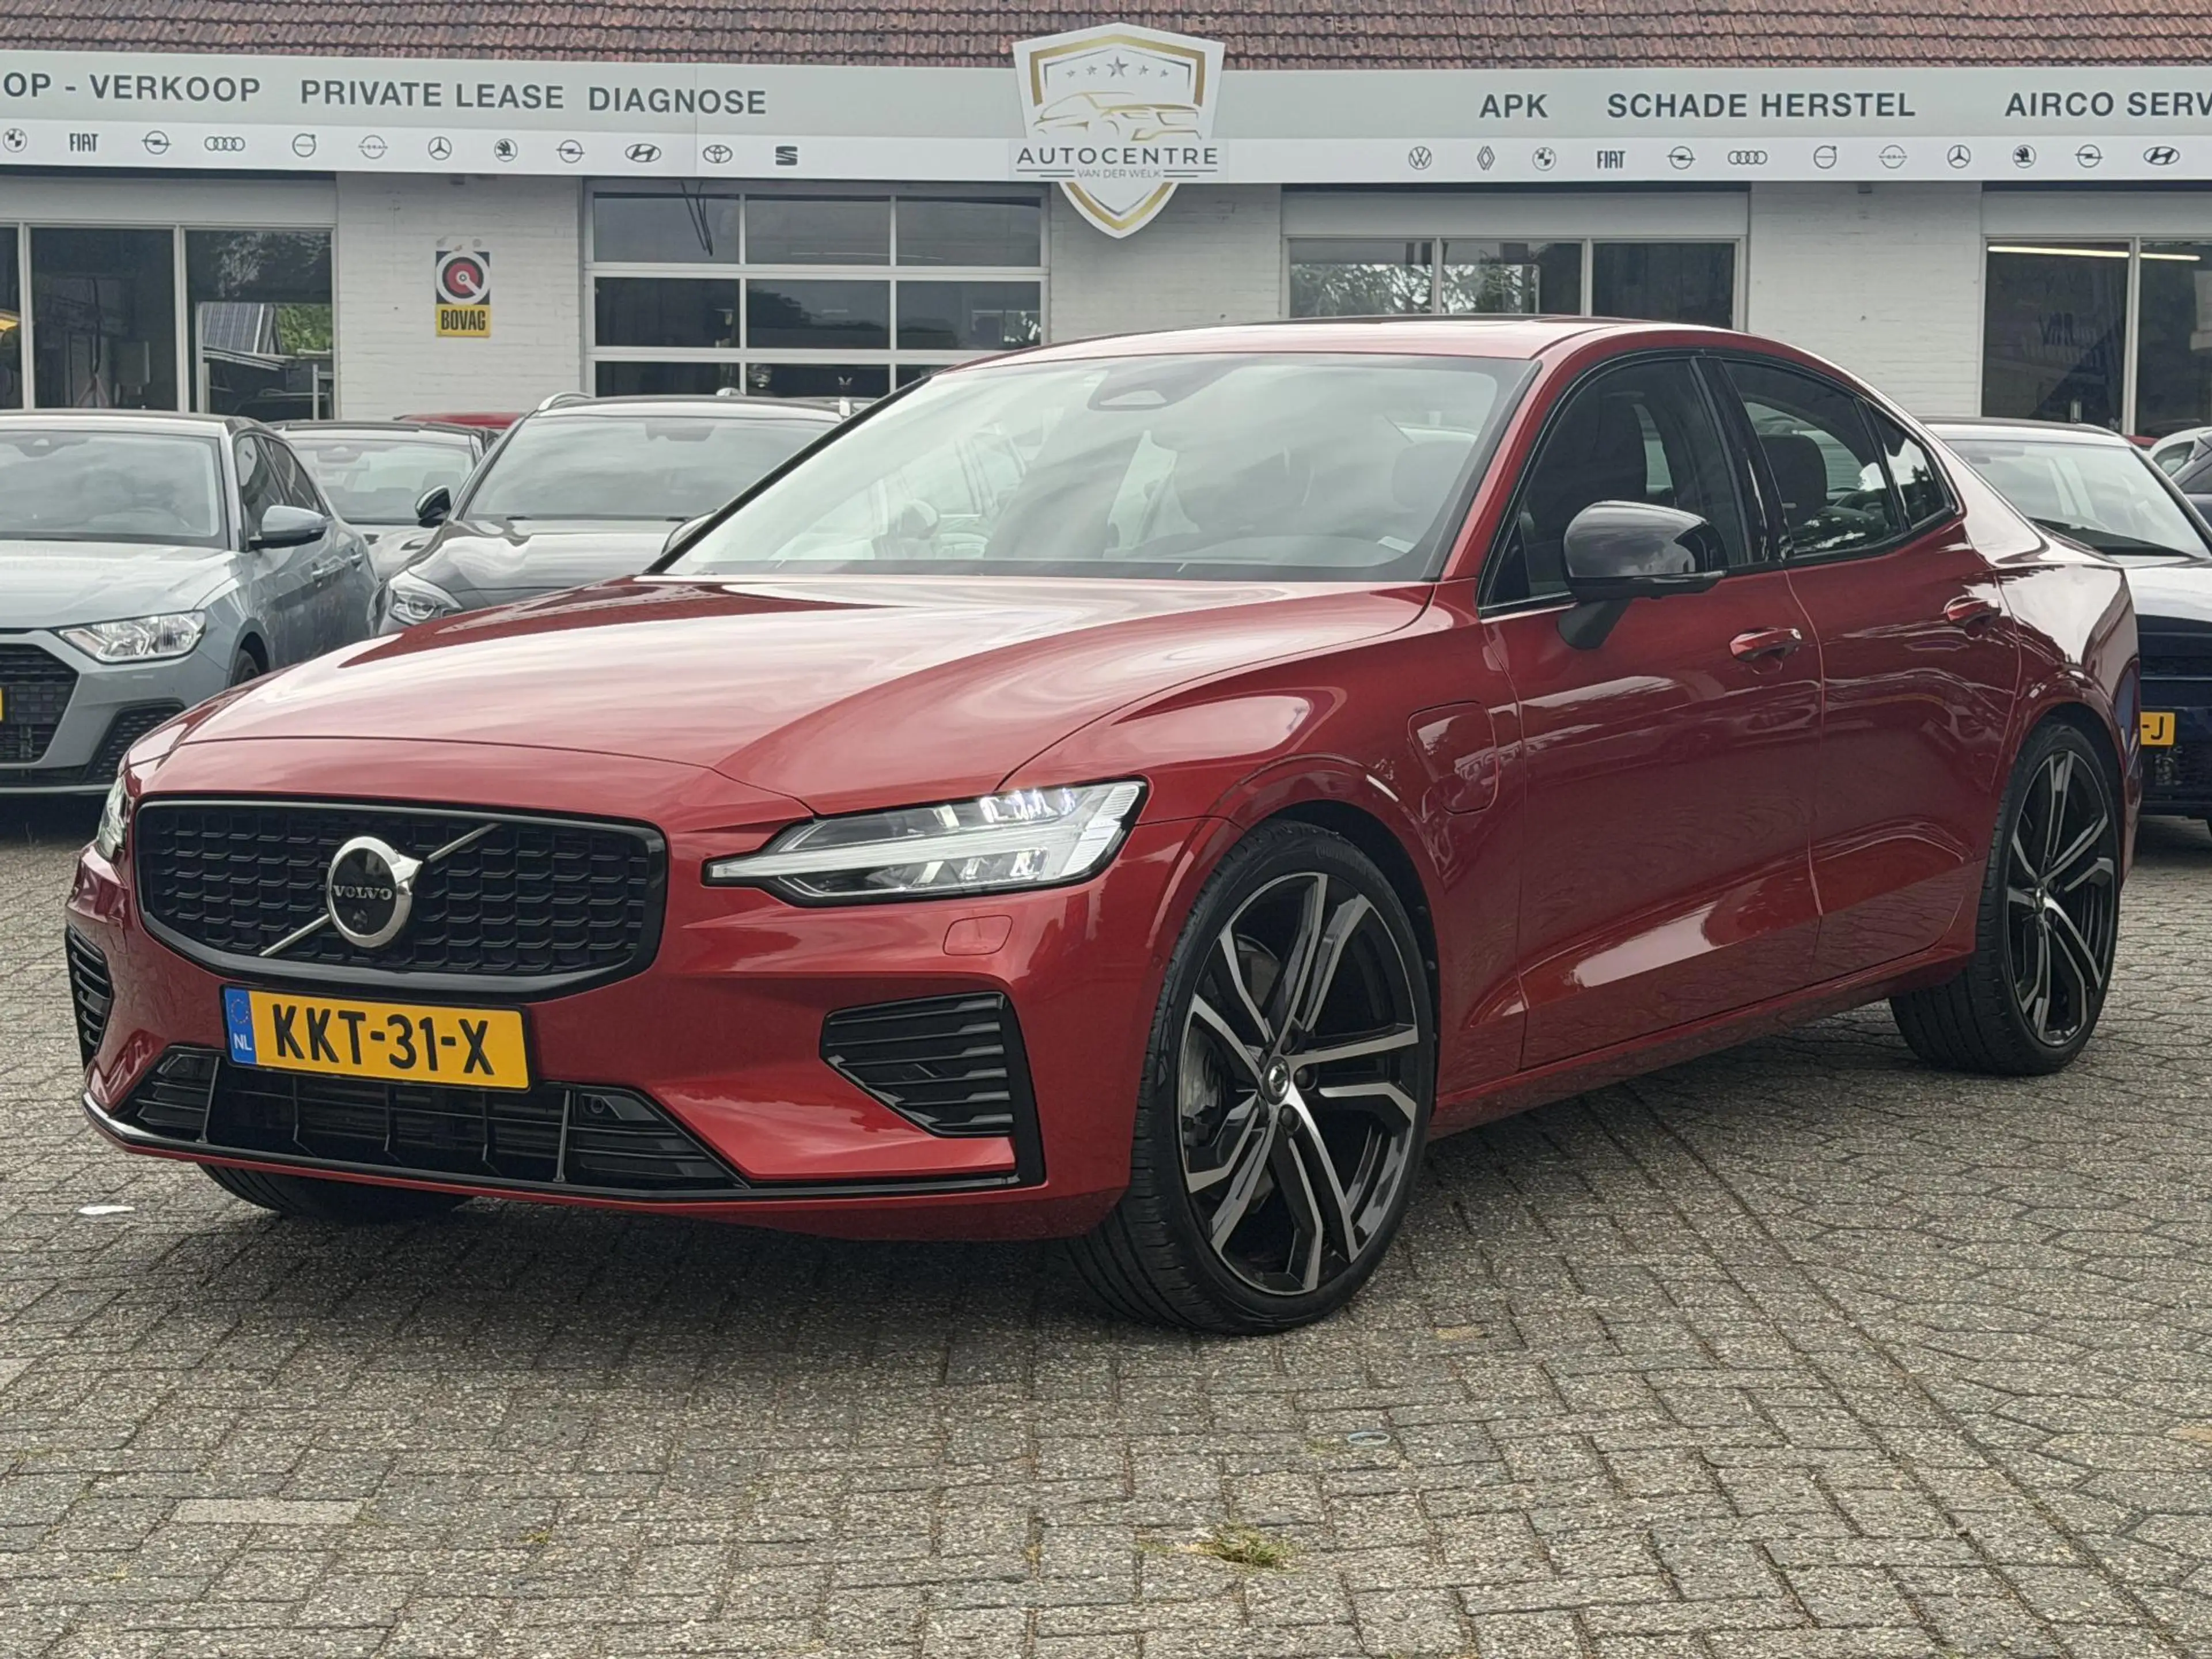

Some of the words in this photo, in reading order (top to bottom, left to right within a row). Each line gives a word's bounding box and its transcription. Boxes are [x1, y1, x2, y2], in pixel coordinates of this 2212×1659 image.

[3, 72, 51, 97] OP
[89, 74, 260, 102] VERKOOP
[301, 80, 442, 107] PRIVATE
[456, 84, 564, 109] LEASE
[589, 86, 766, 115] DIAGNOSE
[1479, 94, 1548, 118] APK
[1607, 93, 1747, 118] SCHADE
[1761, 93, 1915, 118] HERSTEL
[2005, 92, 2114, 116] AIRCO
[2127, 92, 2212, 116] SERV
[69, 133, 99, 152] FIAT
[1017, 147, 1218, 165] AUTOCENTRE
[1597, 150, 1626, 169] FIAT
[1078, 169, 1100, 179] VAN
[1103, 169, 1127, 179] DER
[441, 309, 486, 331] BOVAG
[332, 885, 393, 900] VOLVO
[233, 1033, 253, 1052] NL
[272, 1003, 495, 1076] KKT-31-X
